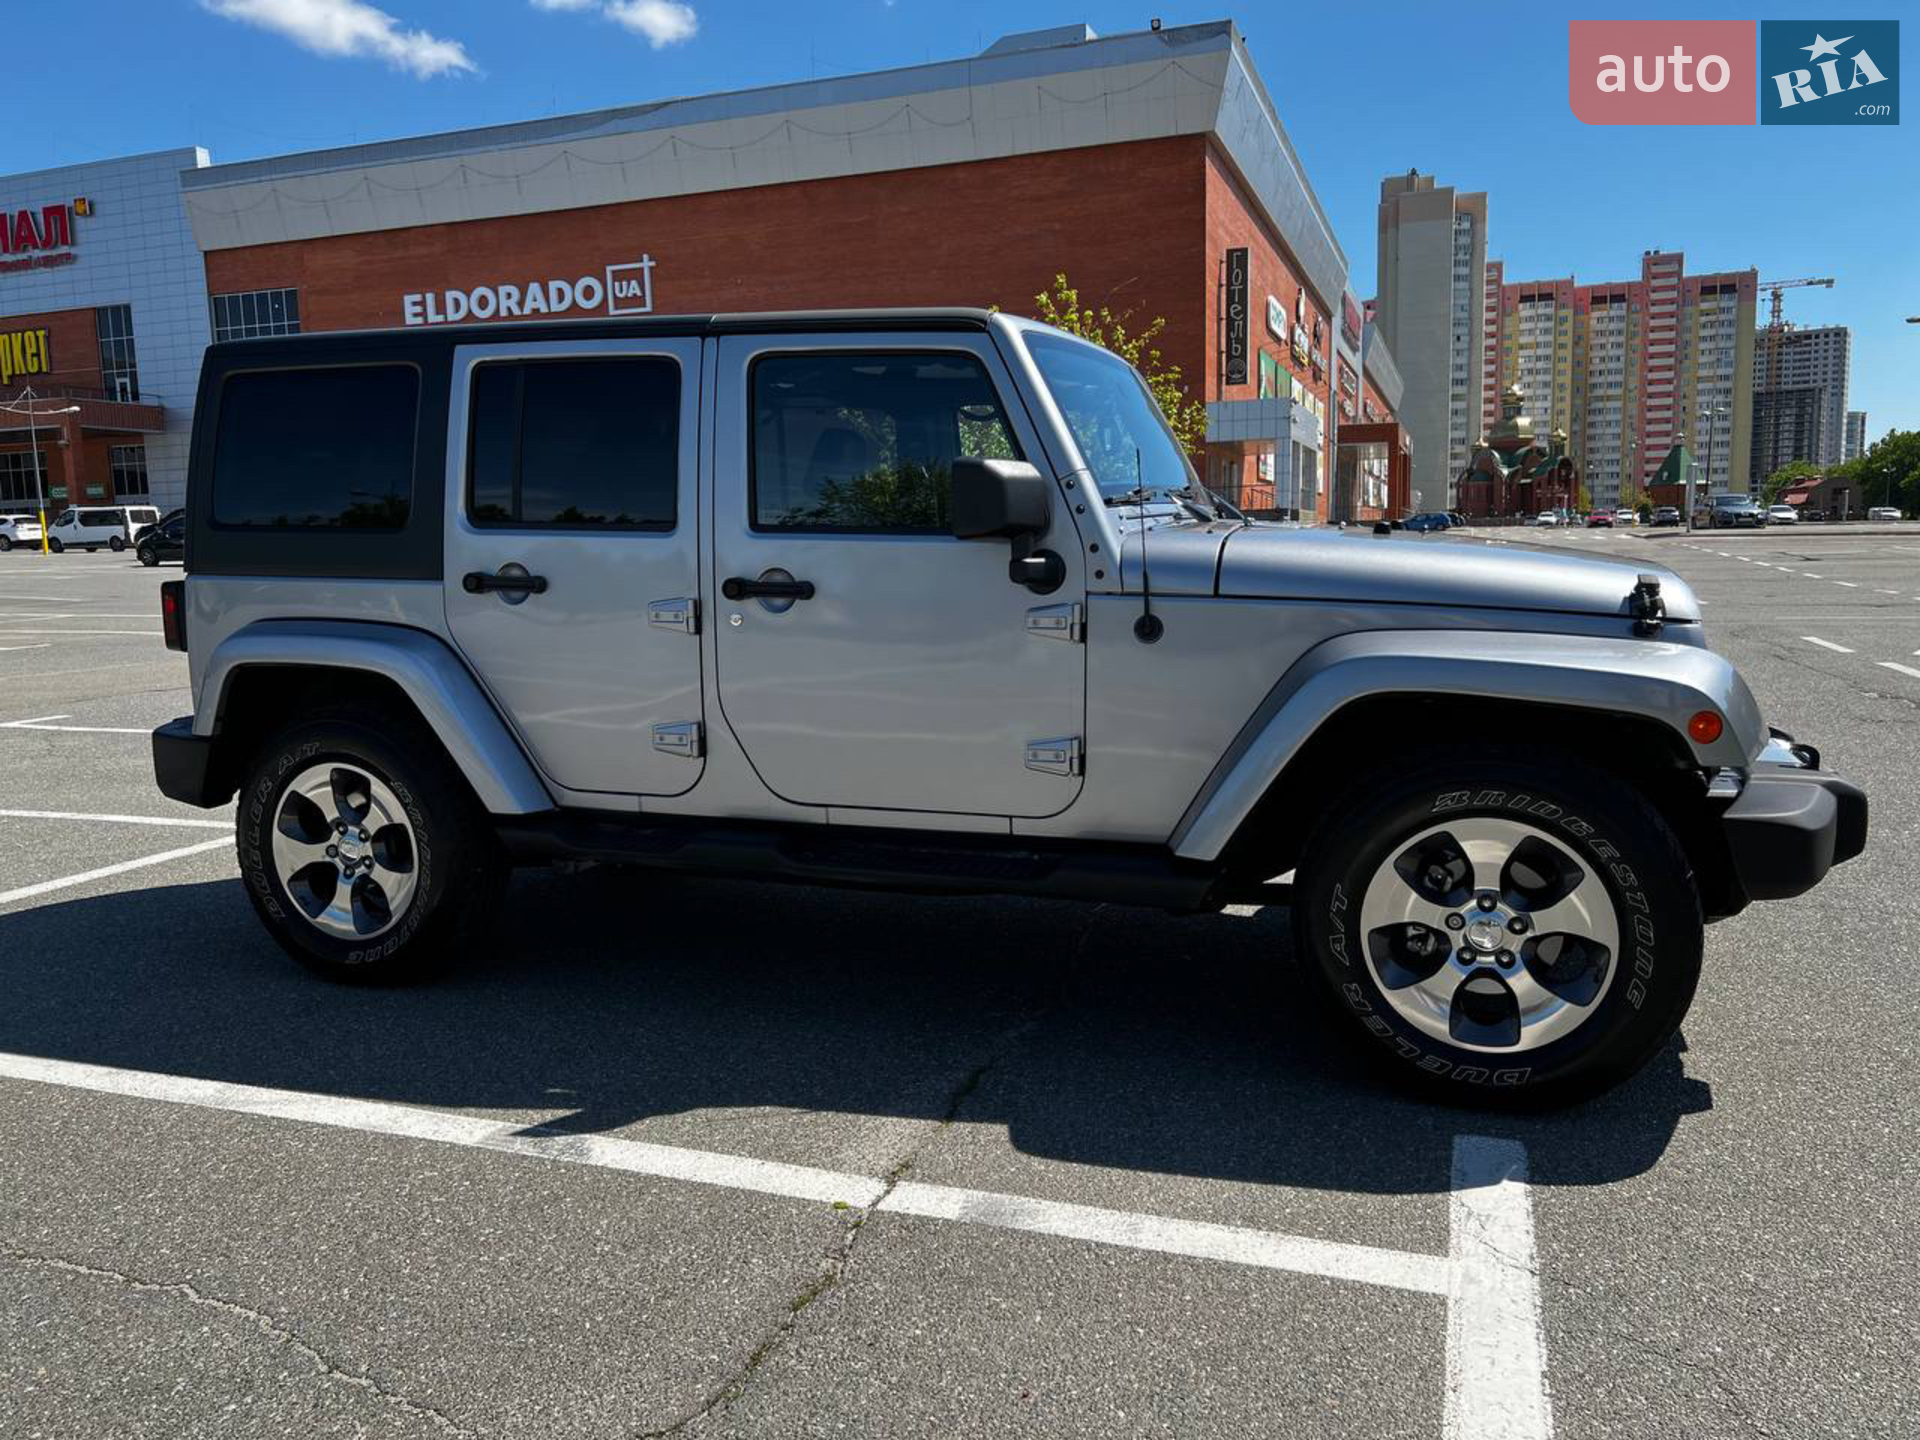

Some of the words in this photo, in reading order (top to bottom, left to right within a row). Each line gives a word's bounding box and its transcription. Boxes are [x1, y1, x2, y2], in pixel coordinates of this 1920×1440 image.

[403, 276, 603, 325] ELDORADO
[614, 280, 642, 298] UA
[1328, 884, 1353, 966] A/T
[1432, 790, 1655, 1010] BRIDGESTONE
[1342, 983, 1533, 1086] DUELER
